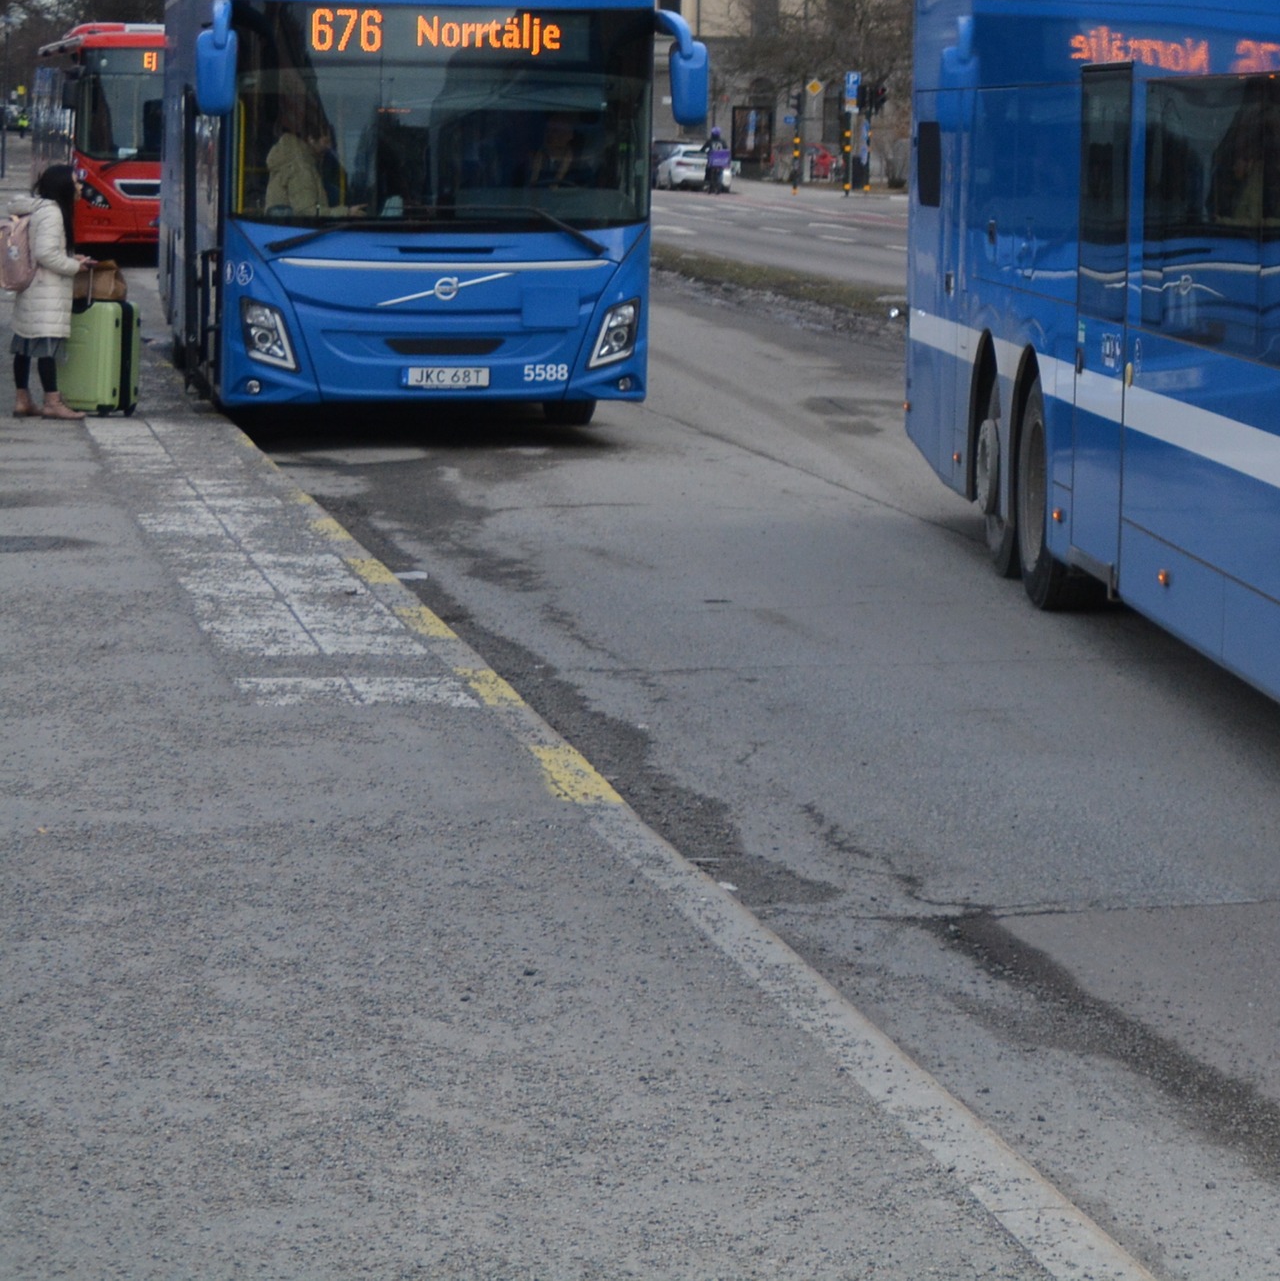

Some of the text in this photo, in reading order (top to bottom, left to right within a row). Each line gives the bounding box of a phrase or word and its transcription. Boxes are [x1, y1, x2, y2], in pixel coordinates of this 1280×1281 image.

[310, 7, 562, 57] 676 Norrtälje
[415, 369, 446, 385] JKC
[450, 369, 483, 384] 68T
[523, 363, 569, 381] 5588
